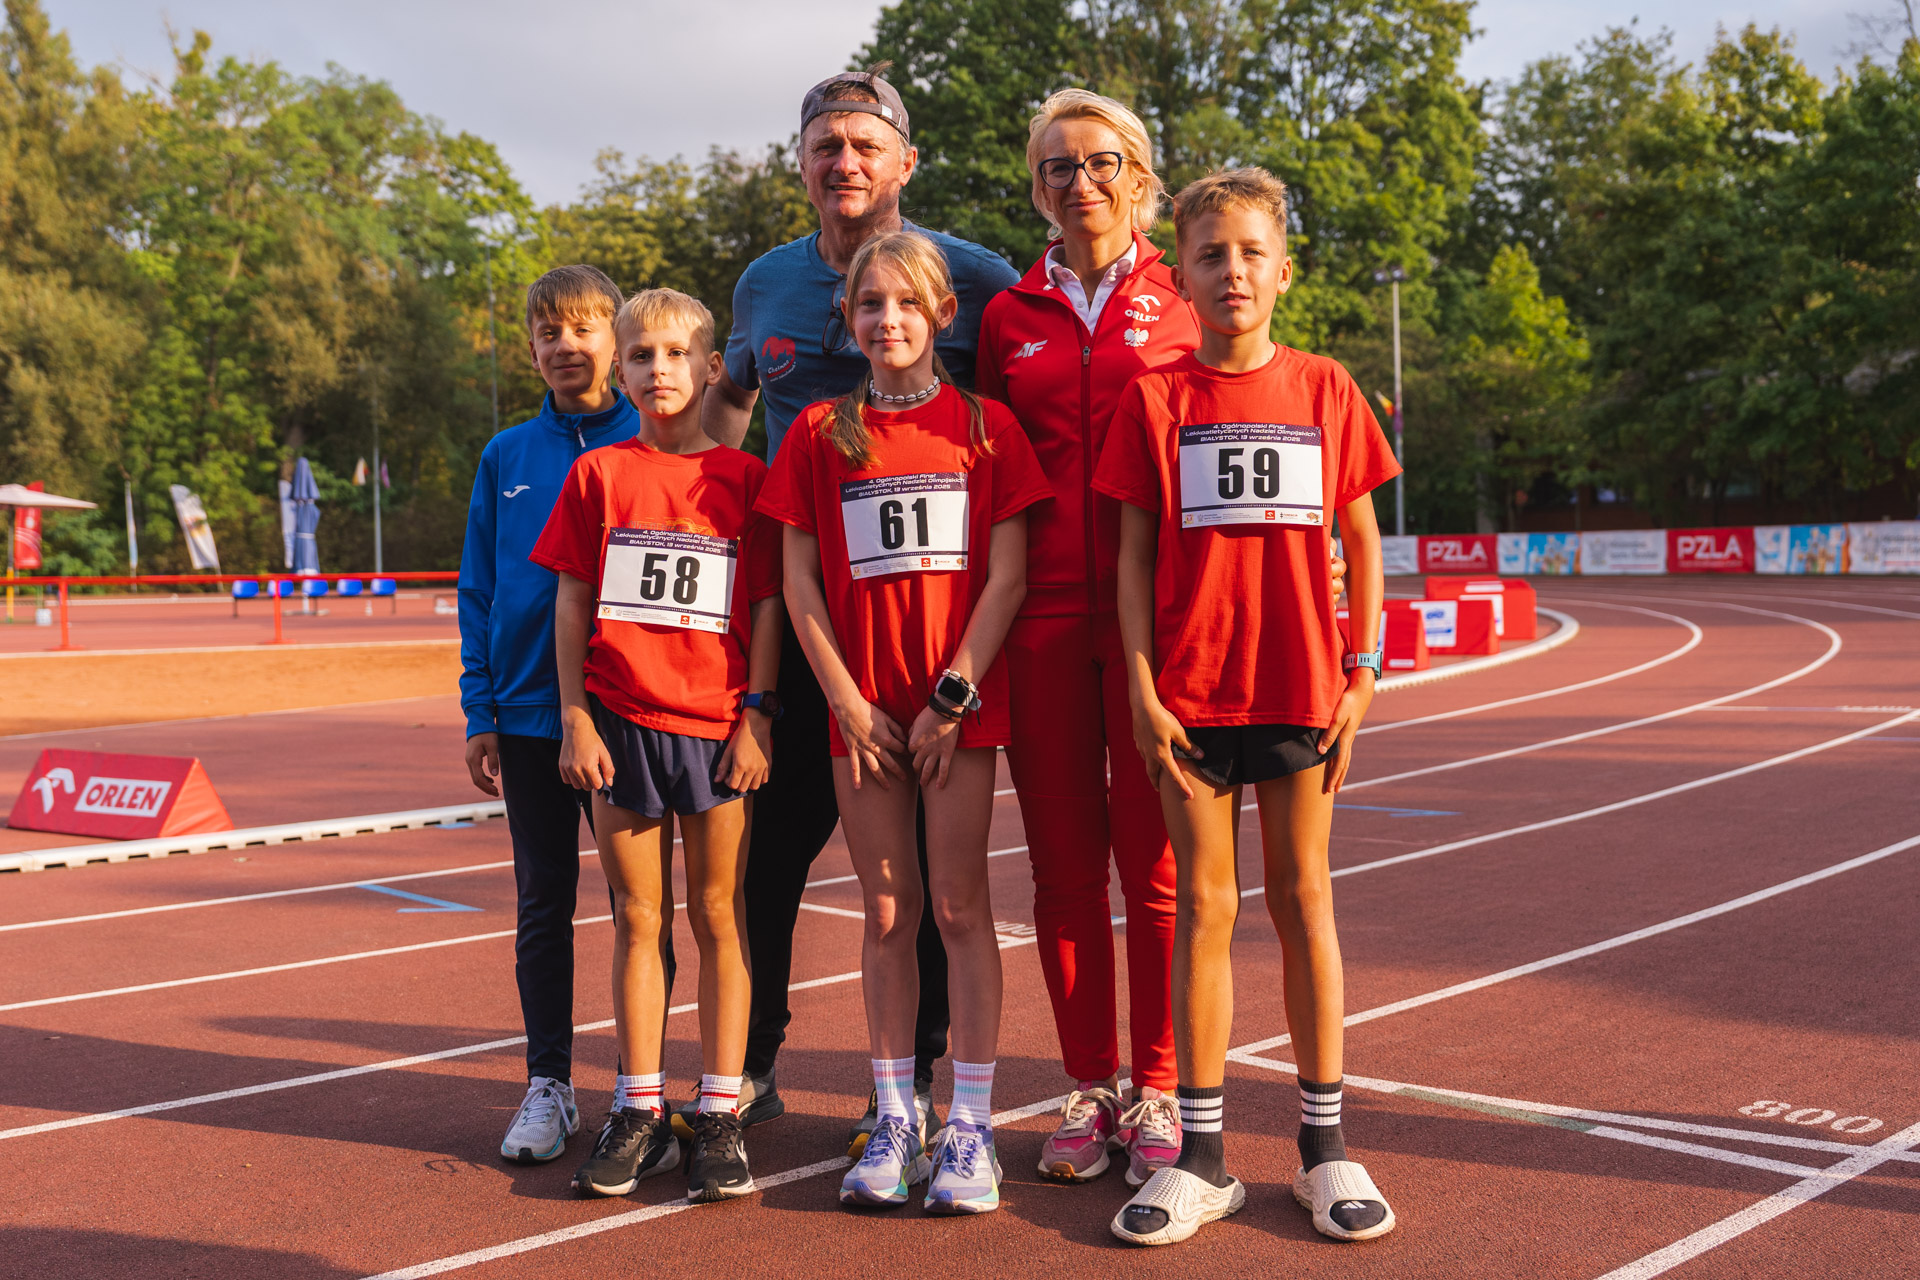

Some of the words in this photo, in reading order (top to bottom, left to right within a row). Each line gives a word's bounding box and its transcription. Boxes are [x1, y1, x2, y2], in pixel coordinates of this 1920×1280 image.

[1124, 309, 1160, 322] ORLEN
[1185, 429, 1249, 437] Lekkoatletycznych
[876, 475, 919, 484] Ogólnopolski
[1218, 447, 1280, 500] 59
[845, 481, 901, 493] Lekkoatletycznych
[879, 498, 930, 550] 61
[615, 532, 675, 542] Lekkoatletycznych
[676, 536, 700, 544] Nadziei
[650, 530, 693, 539] Ogólnopolski
[1426, 540, 1488, 562] PZLA
[1677, 534, 1743, 560] PZLA
[640, 552, 700, 604] 58
[85, 783, 163, 811] ORLEN
